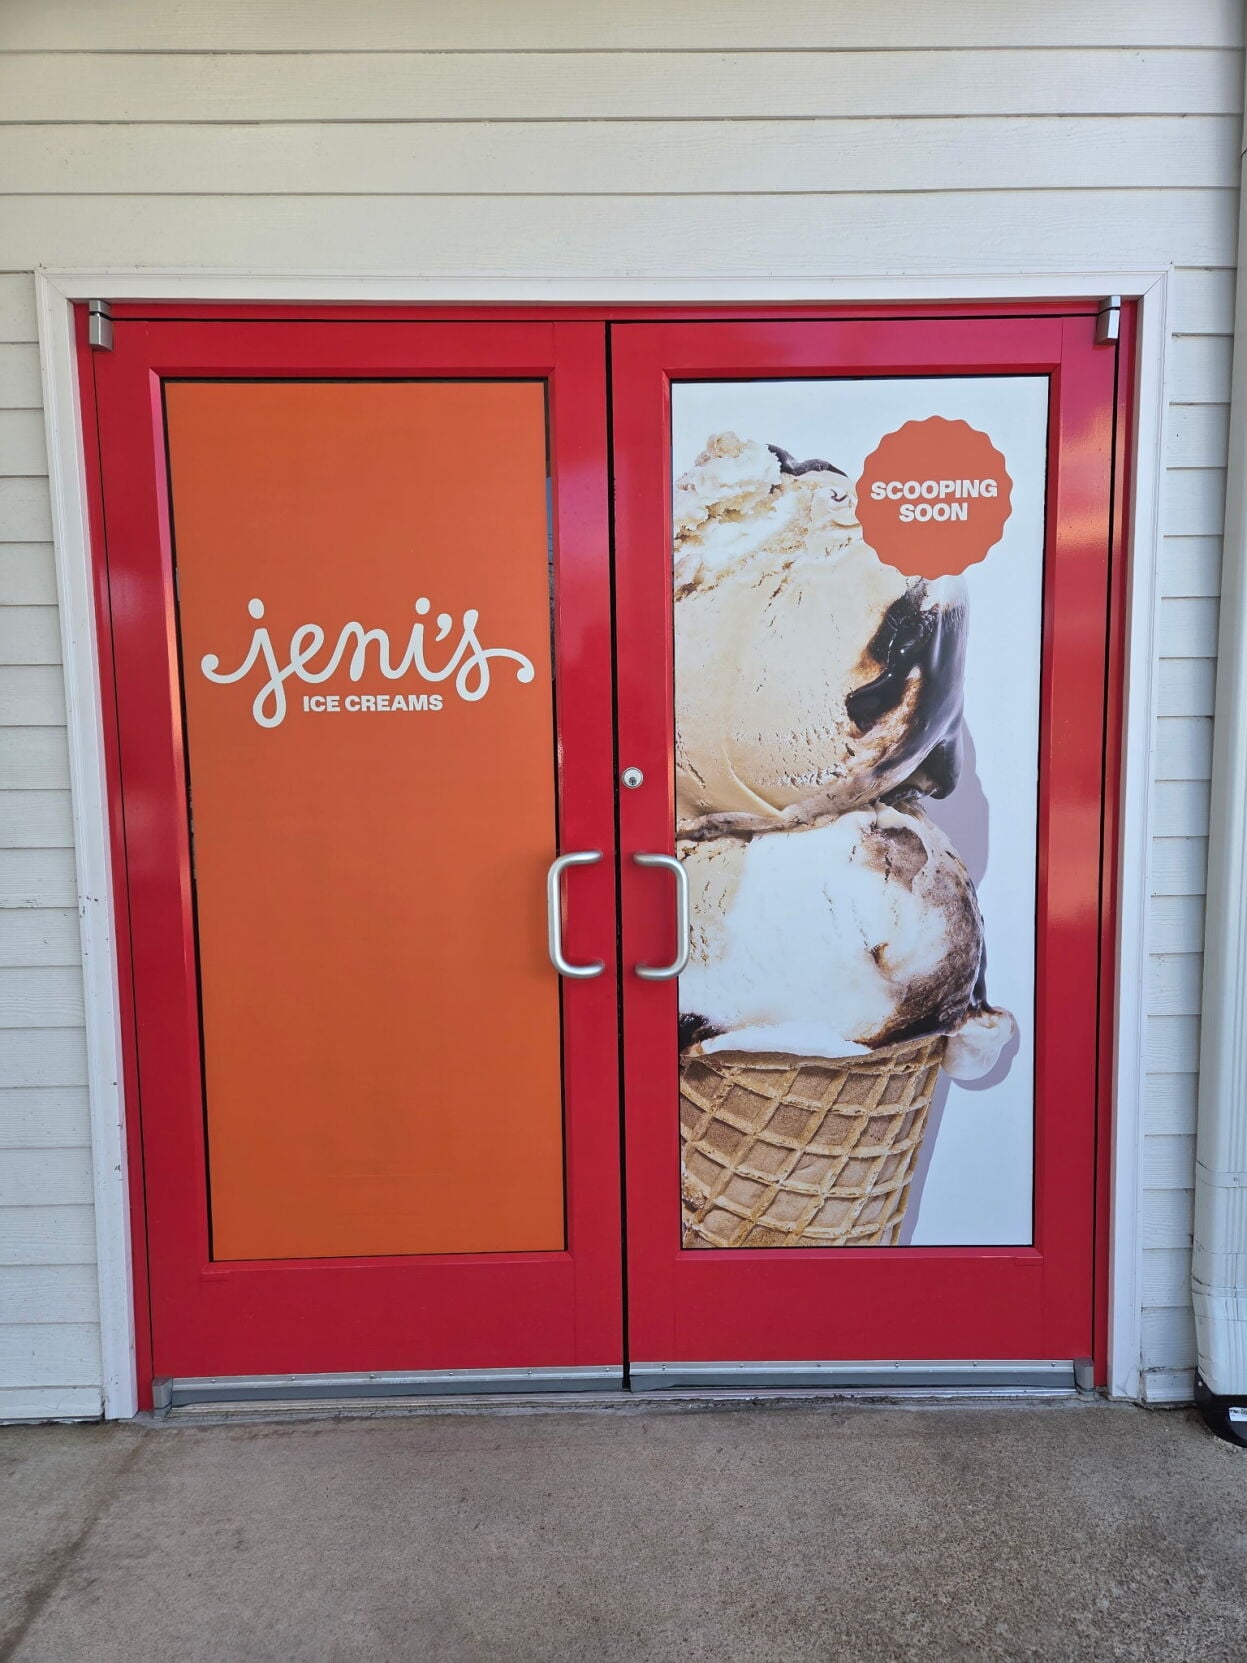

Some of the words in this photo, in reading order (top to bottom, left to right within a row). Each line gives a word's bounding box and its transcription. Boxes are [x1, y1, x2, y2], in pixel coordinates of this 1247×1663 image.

[870, 478, 998, 500] SCOOPING
[898, 502, 968, 522] SOON
[200, 597, 535, 728] jeni's
[303, 695, 341, 712] ICE
[345, 694, 444, 712] CREAMS
